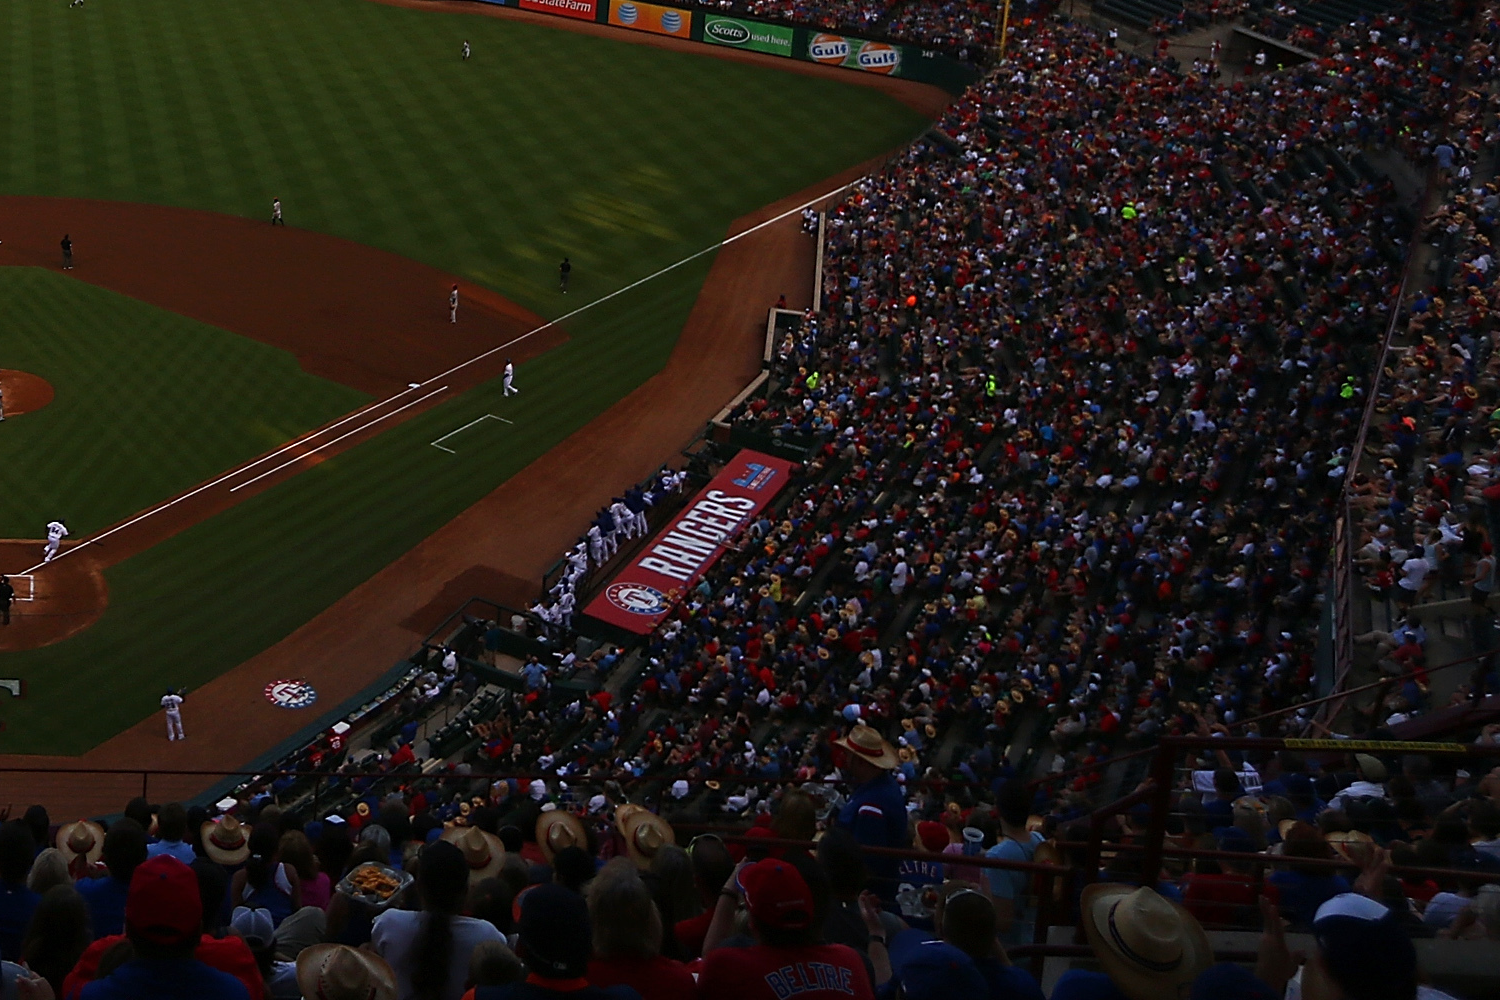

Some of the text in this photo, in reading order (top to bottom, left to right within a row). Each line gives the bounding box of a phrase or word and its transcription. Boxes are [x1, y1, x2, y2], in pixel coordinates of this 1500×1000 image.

[709, 23, 791, 47] Scotts used here.
[811, 43, 848, 57] Gulf
[859, 51, 898, 66] Gulf
[637, 489, 757, 582] RANGERS
[763, 960, 856, 1000] BELTRE
